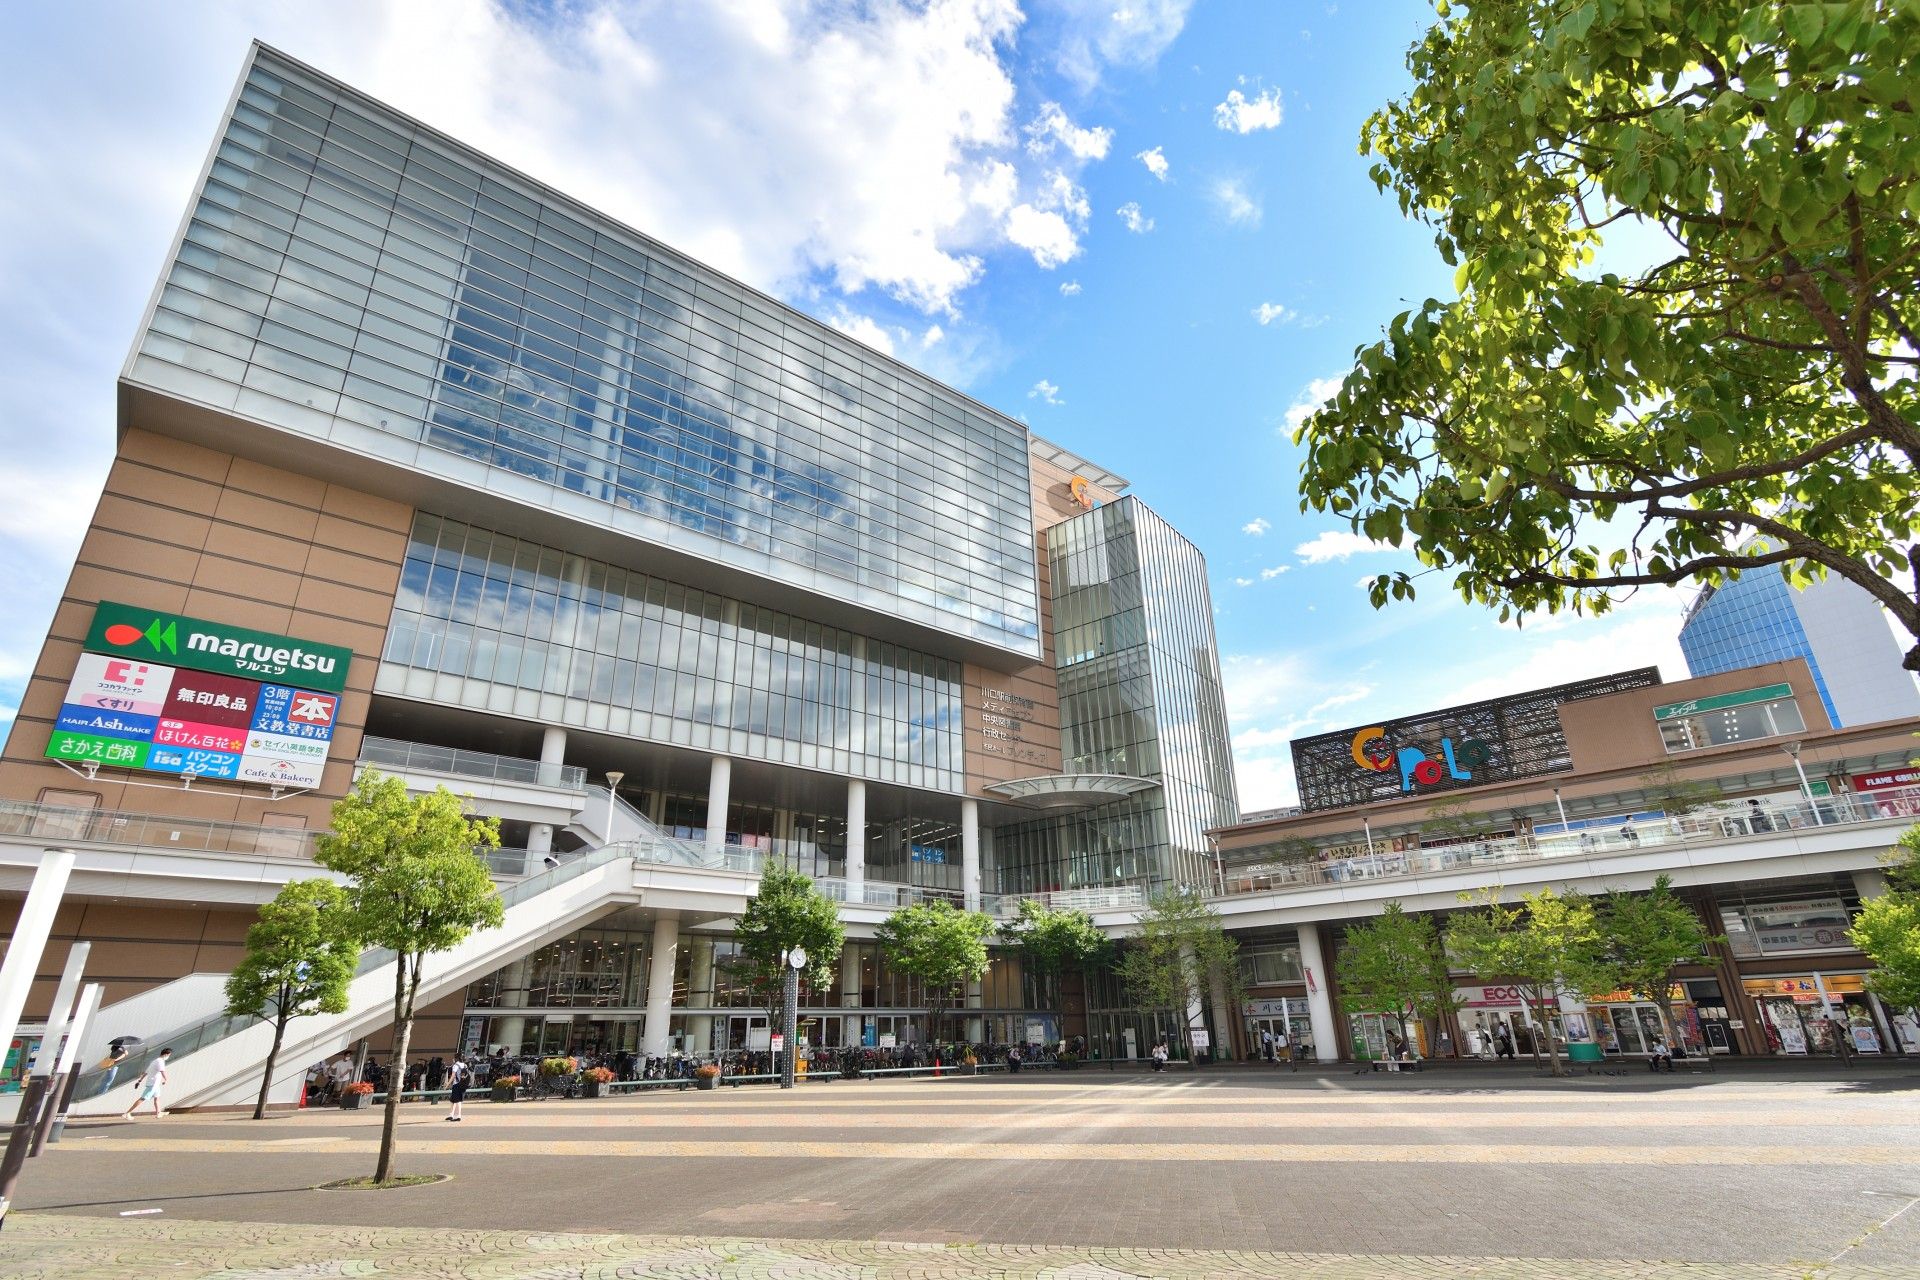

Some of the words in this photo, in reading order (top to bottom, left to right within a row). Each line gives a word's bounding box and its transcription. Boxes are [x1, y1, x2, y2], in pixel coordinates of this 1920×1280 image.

[187, 632, 335, 674] maruetsu
[234, 658, 286, 675] マルエツ
[97, 682, 143, 694] ココカラファイン
[264, 686, 290, 700] 3階
[96, 697, 134, 711] くすり
[177, 687, 248, 712] 無印良品
[291, 697, 332, 721] 本
[62, 717, 89, 726] HAIR
[89, 716, 123, 731] Ash
[123, 726, 152, 735] MAKE
[255, 718, 329, 739] 文教堂書店
[159, 729, 230, 749] ほけん百花
[59, 737, 138, 763] さかえ歯科
[187, 751, 235, 765] パソコン
[183, 762, 231, 776] スクール
[244, 768, 268, 777] Cafe
[269, 770, 278, 779] &
[280, 772, 315, 785] Bakery
[1865, 776, 1894, 786] FLAME
